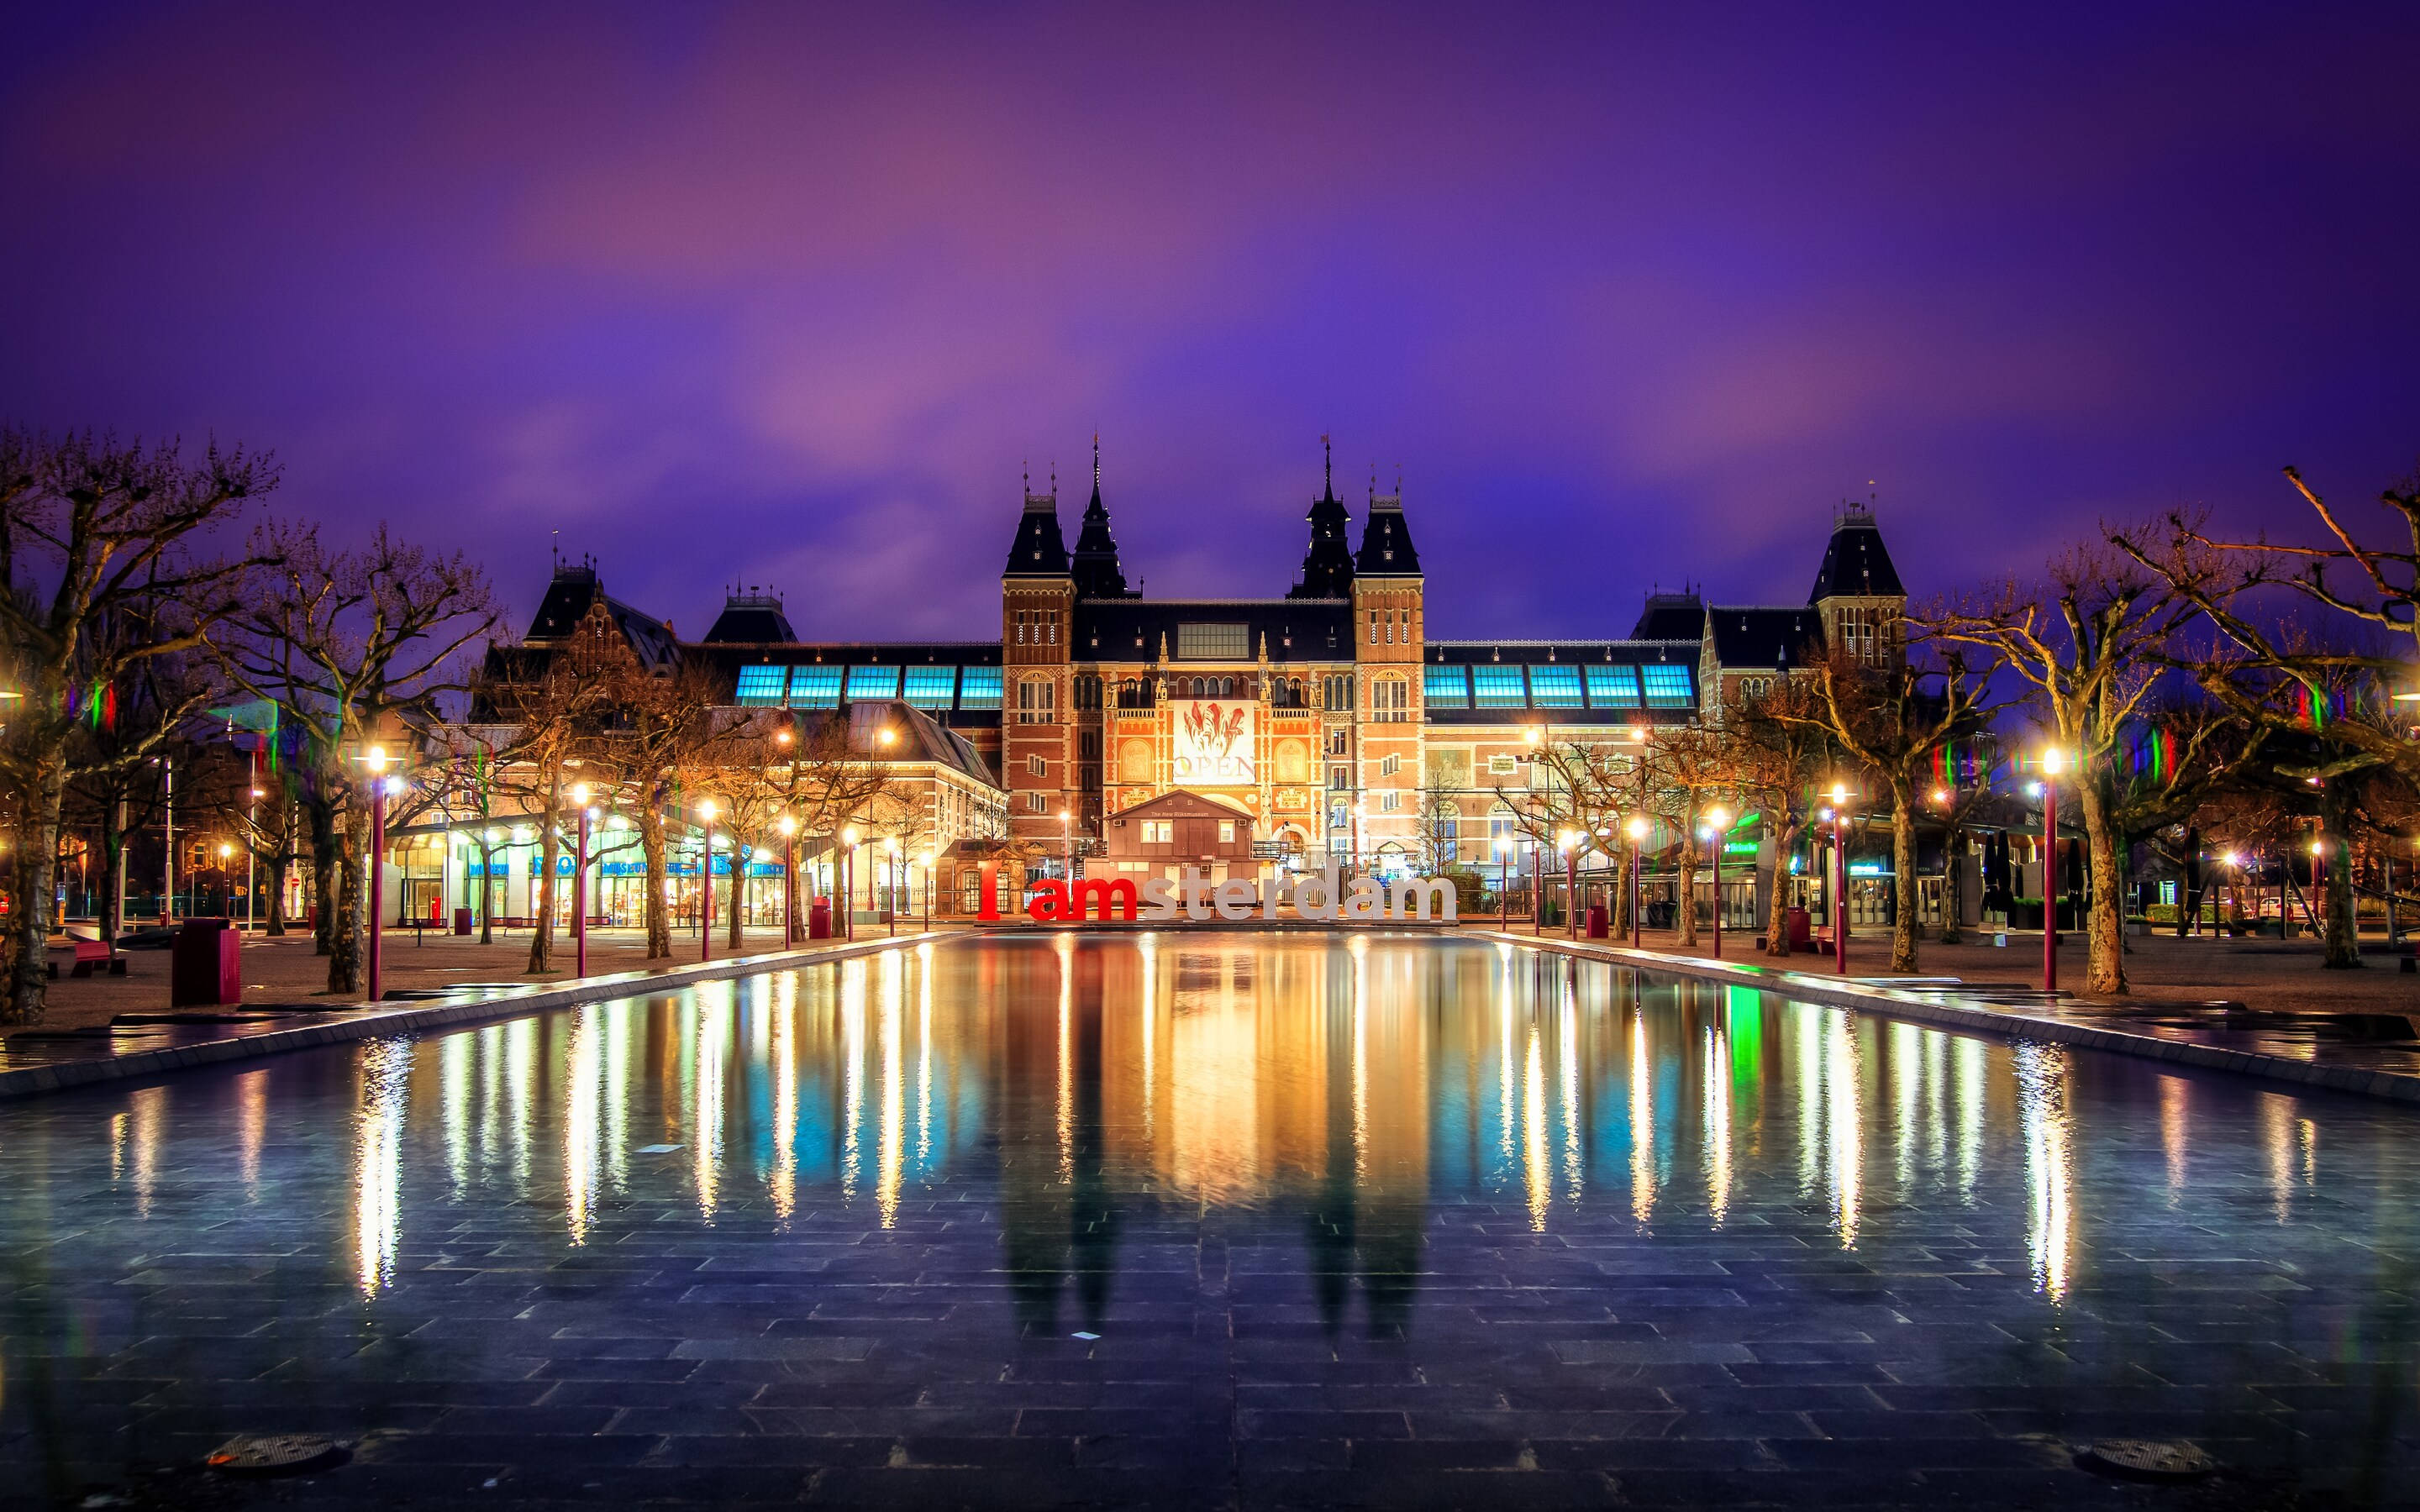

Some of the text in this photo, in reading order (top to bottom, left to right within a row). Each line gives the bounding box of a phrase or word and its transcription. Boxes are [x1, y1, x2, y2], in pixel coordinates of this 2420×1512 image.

[1174, 756, 1255, 777] OPEN
[977, 857, 1457, 921] I amsterdam
